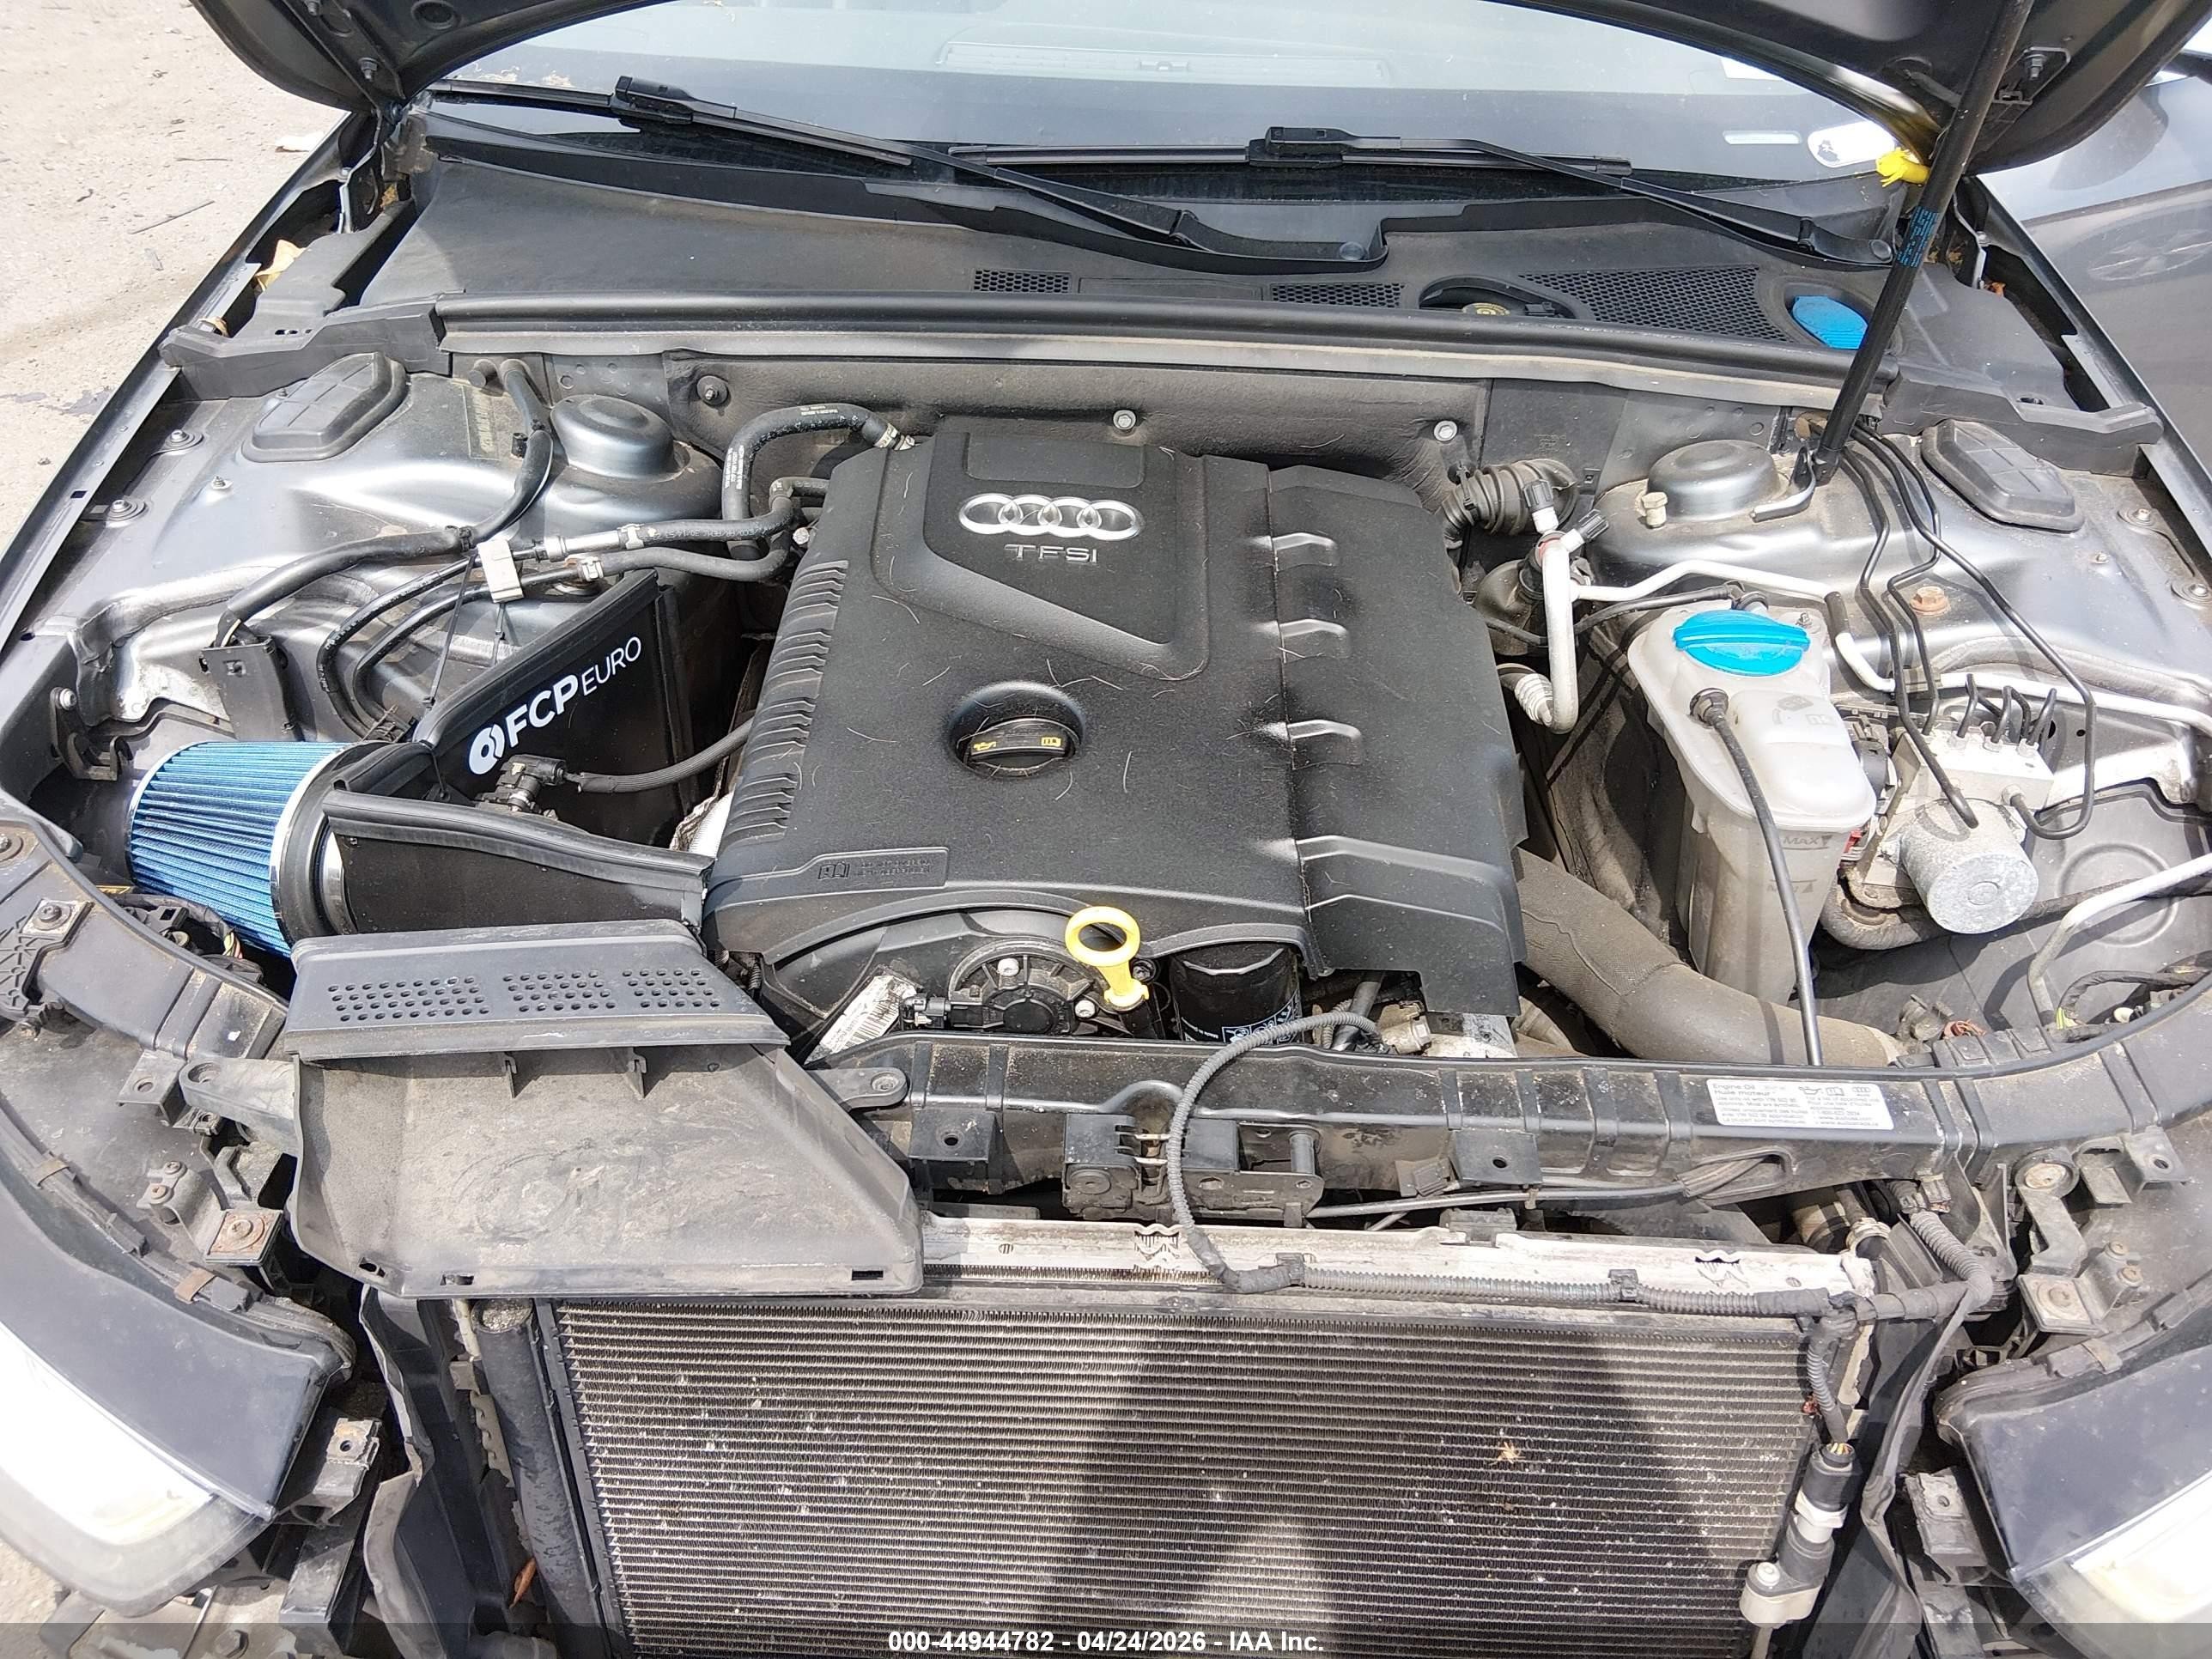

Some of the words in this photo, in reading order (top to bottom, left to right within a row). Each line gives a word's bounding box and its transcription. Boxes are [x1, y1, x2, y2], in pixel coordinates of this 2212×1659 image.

[1004, 544, 1097, 564] TFSI
[506, 674, 579, 748] FCP
[580, 636, 641, 696] EURO
[1783, 836, 1819, 845] MAX
